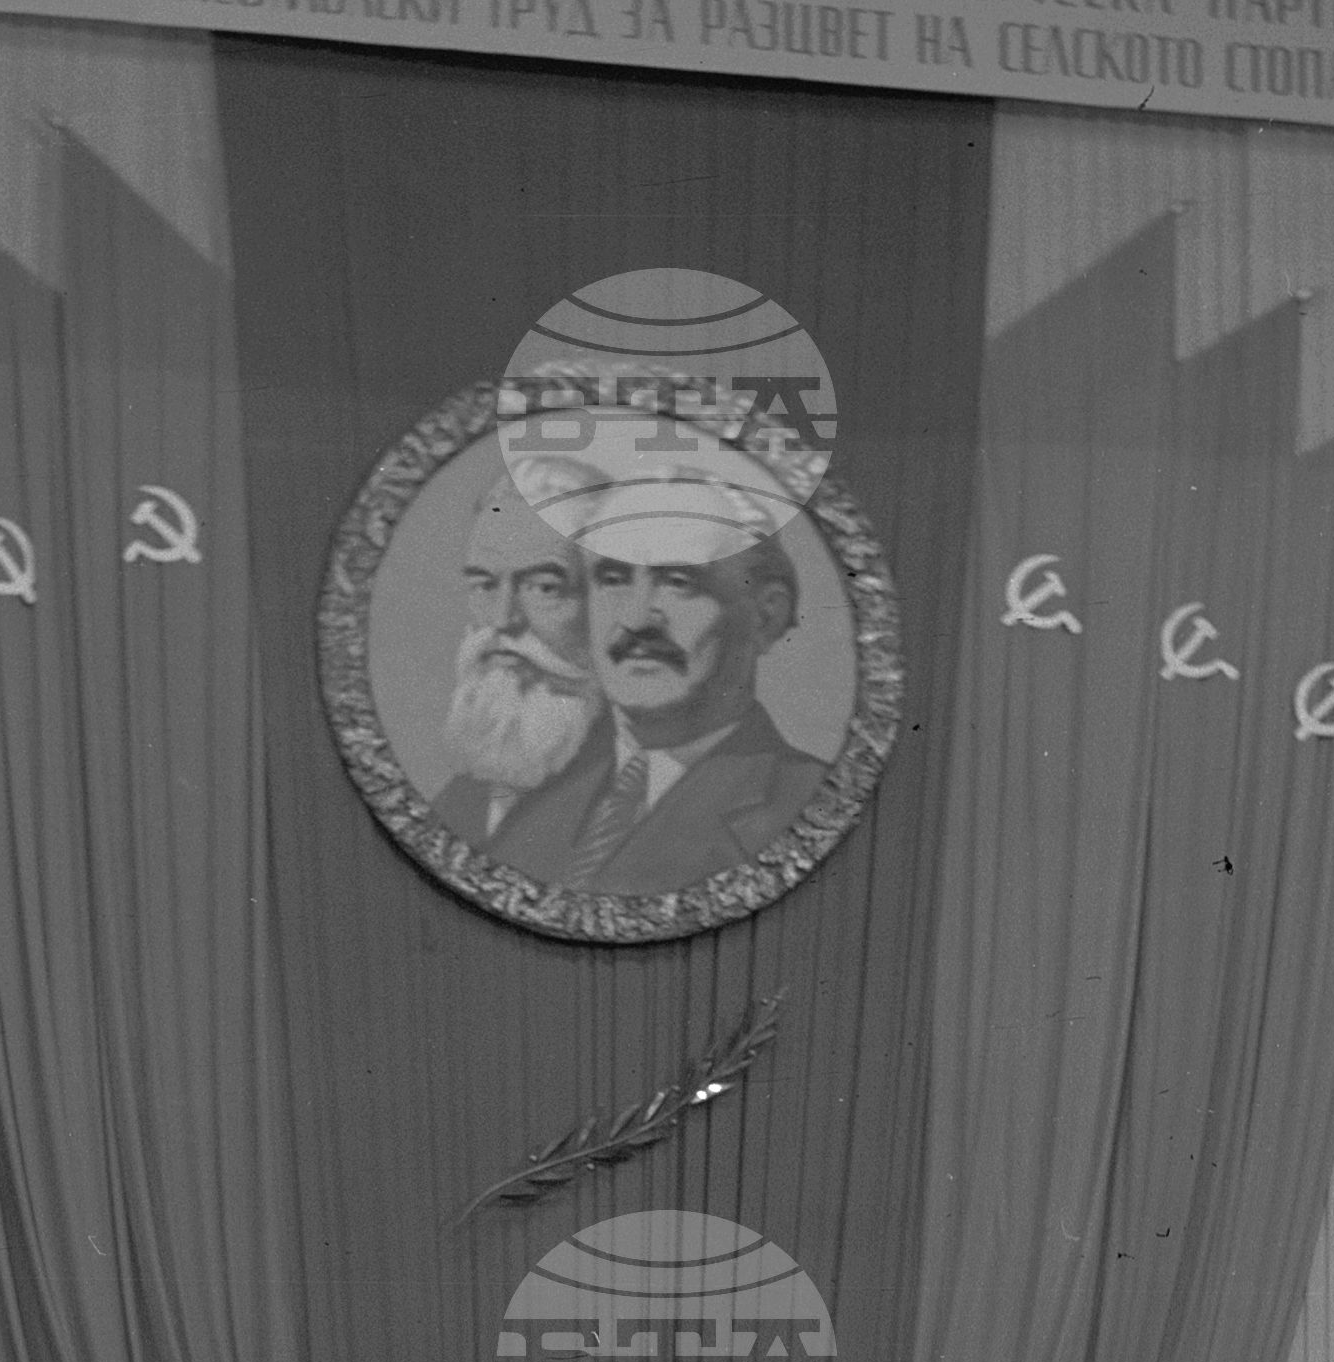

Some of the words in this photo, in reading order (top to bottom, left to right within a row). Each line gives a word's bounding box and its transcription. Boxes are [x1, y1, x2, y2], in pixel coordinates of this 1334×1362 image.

[620, 0, 674, 42] ЗА
[699, 0, 896, 61] РАЗЦВЕТ
[914, 12, 973, 68] НА
[996, 20, 1205, 88] СЕЛСКОТО
